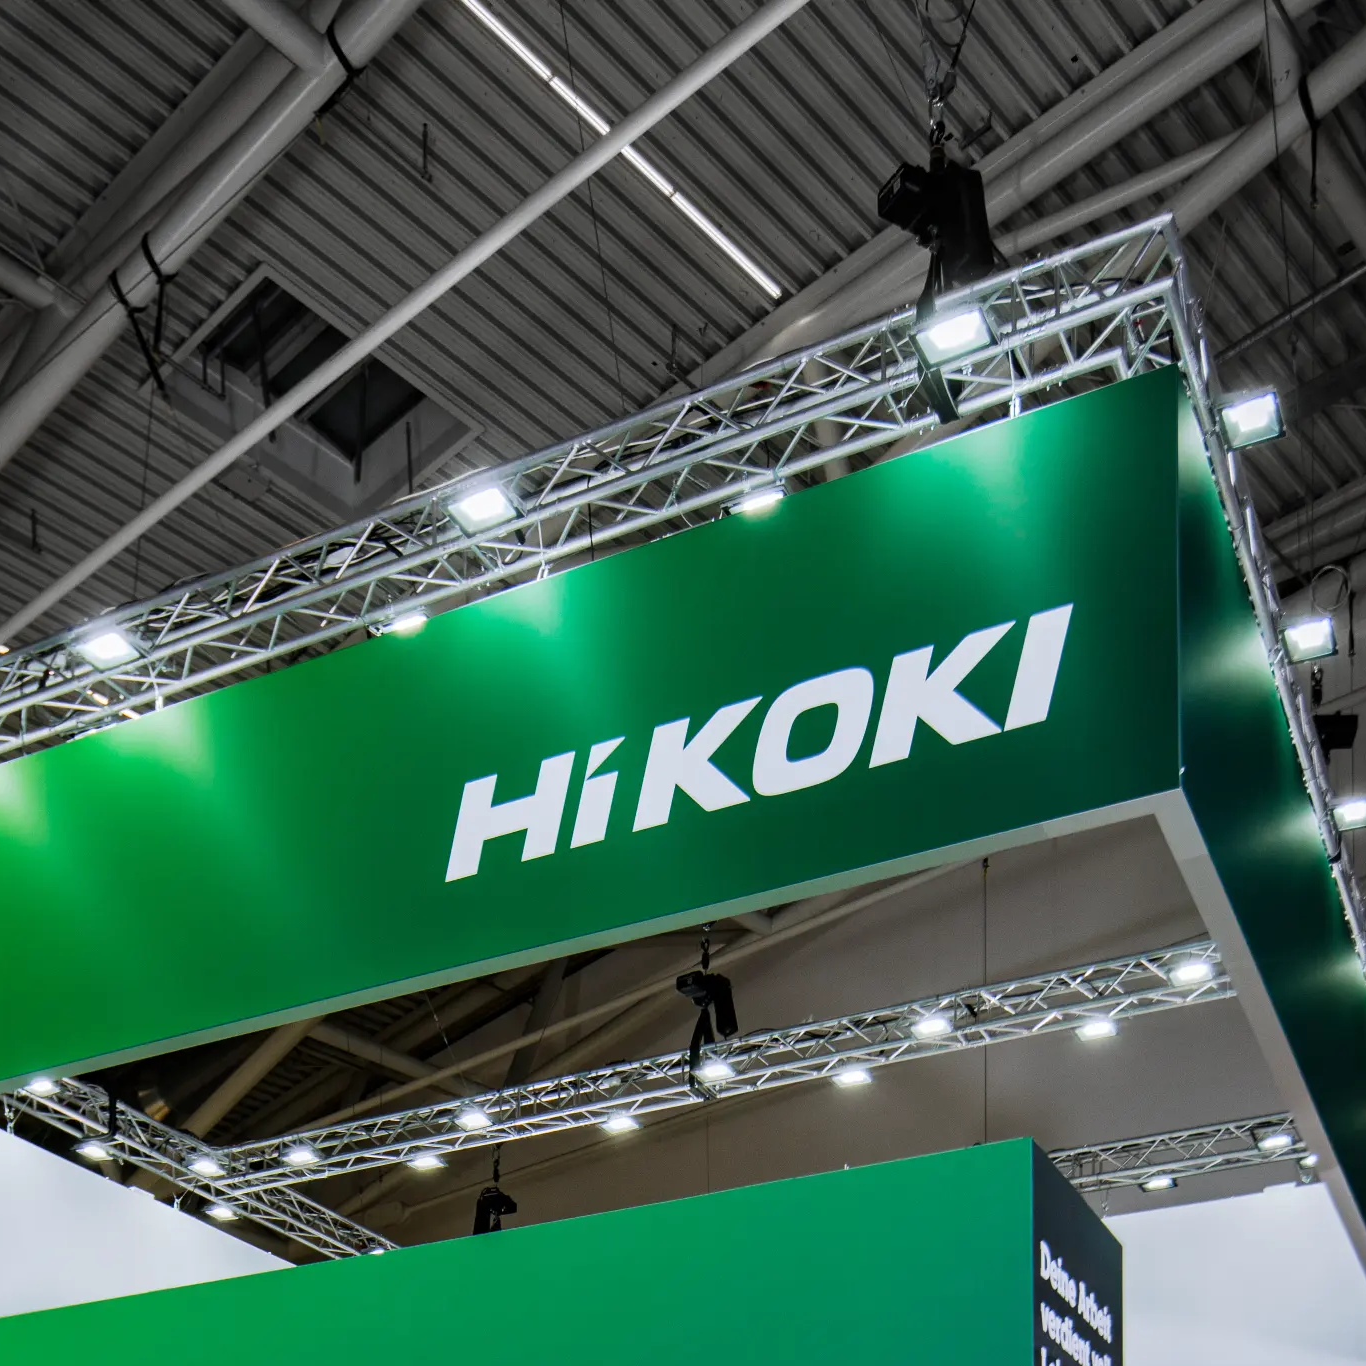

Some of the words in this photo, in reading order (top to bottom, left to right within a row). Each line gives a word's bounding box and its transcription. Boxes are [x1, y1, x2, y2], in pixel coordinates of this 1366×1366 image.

[445, 603, 1073, 882] HiKOKI
[1040, 1240, 1077, 1307] Deine
[1078, 1280, 1112, 1344] Arbeit
